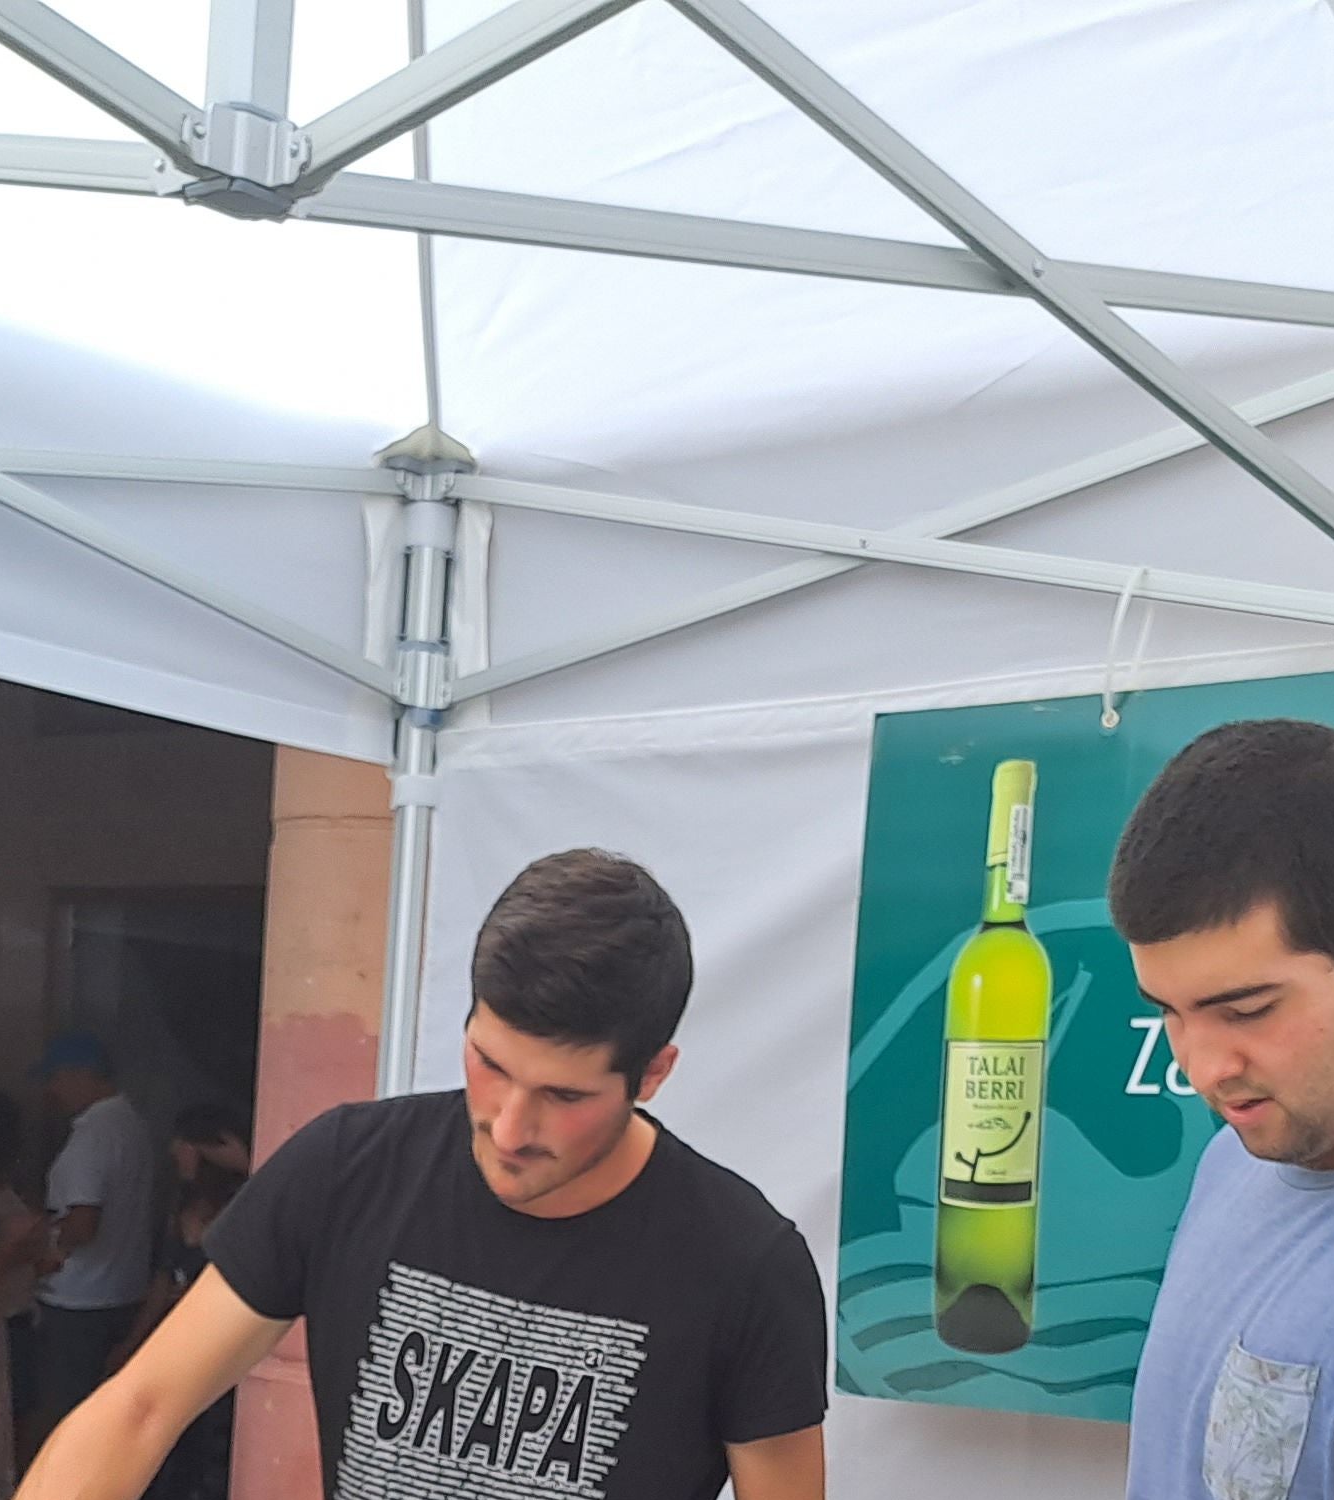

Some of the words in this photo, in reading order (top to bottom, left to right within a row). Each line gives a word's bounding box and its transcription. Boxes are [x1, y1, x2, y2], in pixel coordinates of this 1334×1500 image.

[966, 1056, 1027, 1077] TALAI
[964, 1079, 1025, 1101] BERRI
[376, 1331, 595, 1484] SKAPA
